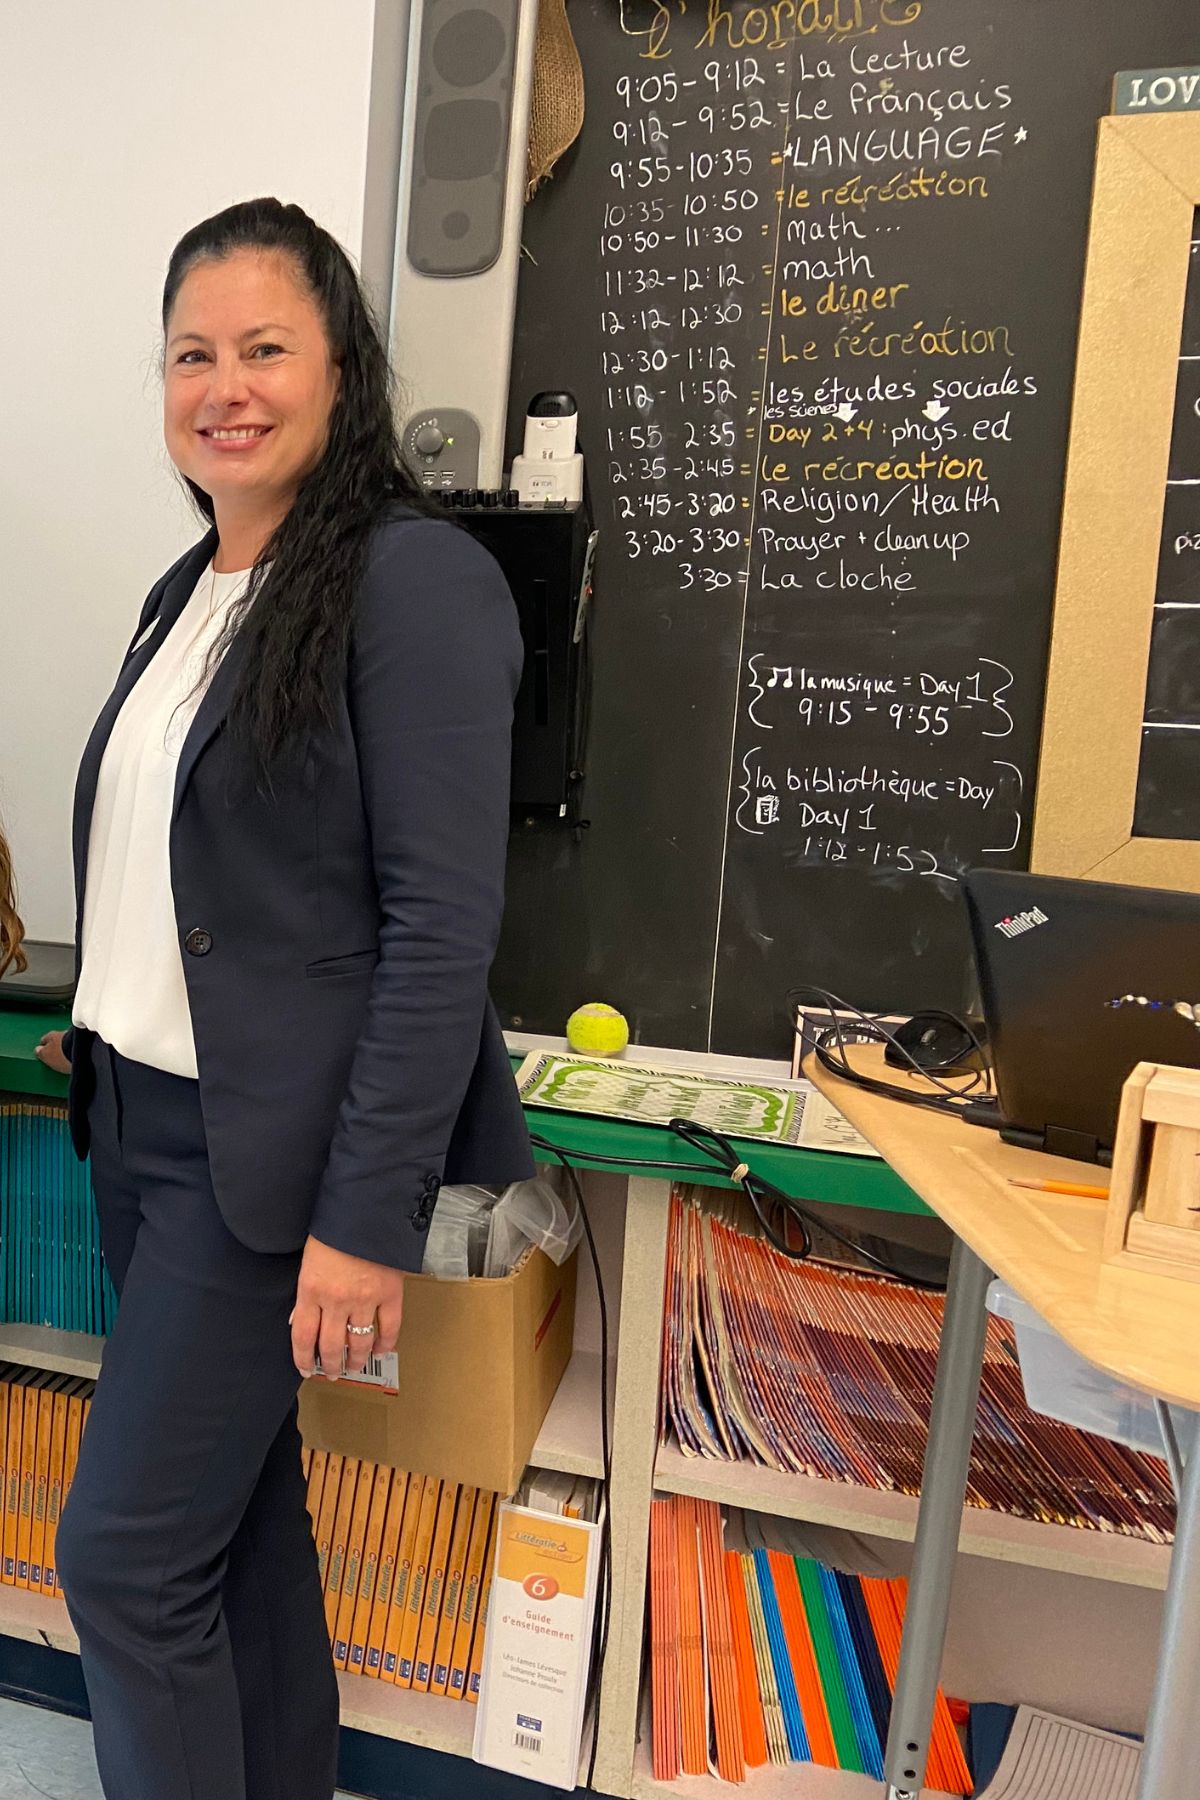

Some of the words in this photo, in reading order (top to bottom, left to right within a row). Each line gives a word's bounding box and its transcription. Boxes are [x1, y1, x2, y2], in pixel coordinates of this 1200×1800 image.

[800, 53, 836, 81] La
[851, 39, 971, 75] lecture
[795, 91, 833, 121] Le
[850, 78, 1012, 122] français
[787, 183, 811, 209] le
[822, 167, 989, 205] récréation
[783, 246, 875, 280] math
[781, 288, 807, 316] le
[781, 334, 818, 363] Le
[834, 315, 1015, 358] récréation
[770, 381, 804, 404] les
[814, 374, 917, 401] études
[933, 366, 1039, 399] sociales
[768, 423, 812, 448] Day
[761, 454, 791, 482] le
[804, 450, 989, 482] récréation
[758, 527, 846, 560] Prayer
[678, 563, 733, 592] 3:30
[761, 564, 797, 591] La
[816, 562, 918, 592] cloche
[821, 672, 897, 700] musique
[919, 672, 961, 703] Day
[755, 765, 777, 790] la
[786, 764, 939, 803] bibliothèque
[957, 777, 995, 810] Day
[800, 802, 850, 834] Day
[858, 803, 877, 831] 1
[994, 905, 1049, 938] ThinkPad
[531, 1579, 546, 1596] 6
[502, 1615, 574, 1642] d'enseignement
[526, 1609, 551, 1625] Guide
